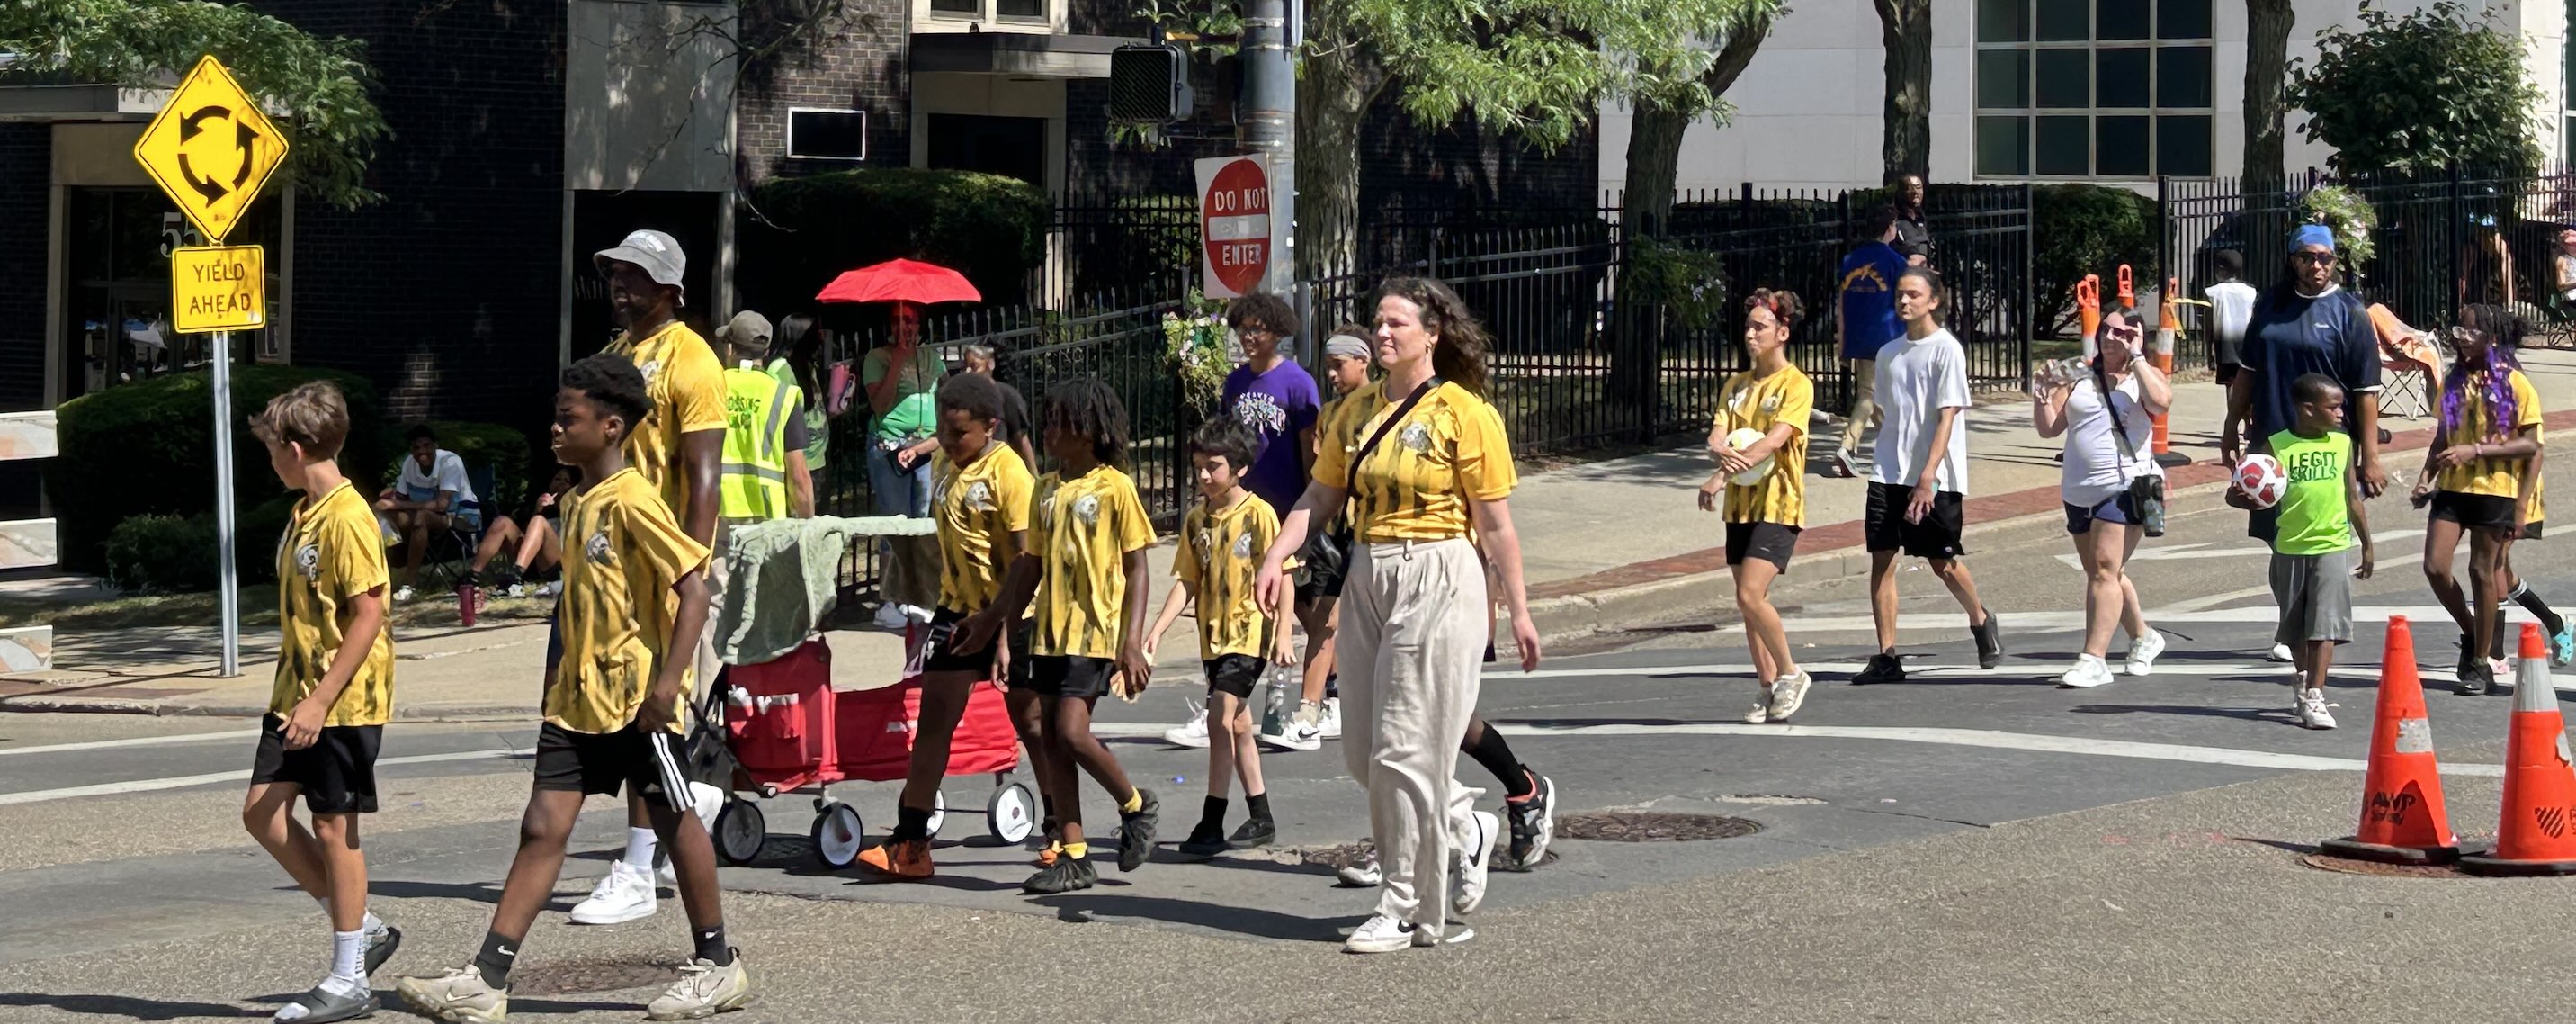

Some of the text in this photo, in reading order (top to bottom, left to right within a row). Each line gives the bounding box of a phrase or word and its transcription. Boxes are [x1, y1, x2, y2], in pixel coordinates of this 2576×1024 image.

[1214, 187, 1266, 212] DO NOT
[1222, 244, 1263, 267] ENTER
[192, 262, 245, 283] YIELD
[189, 292, 252, 316] AHEAD
